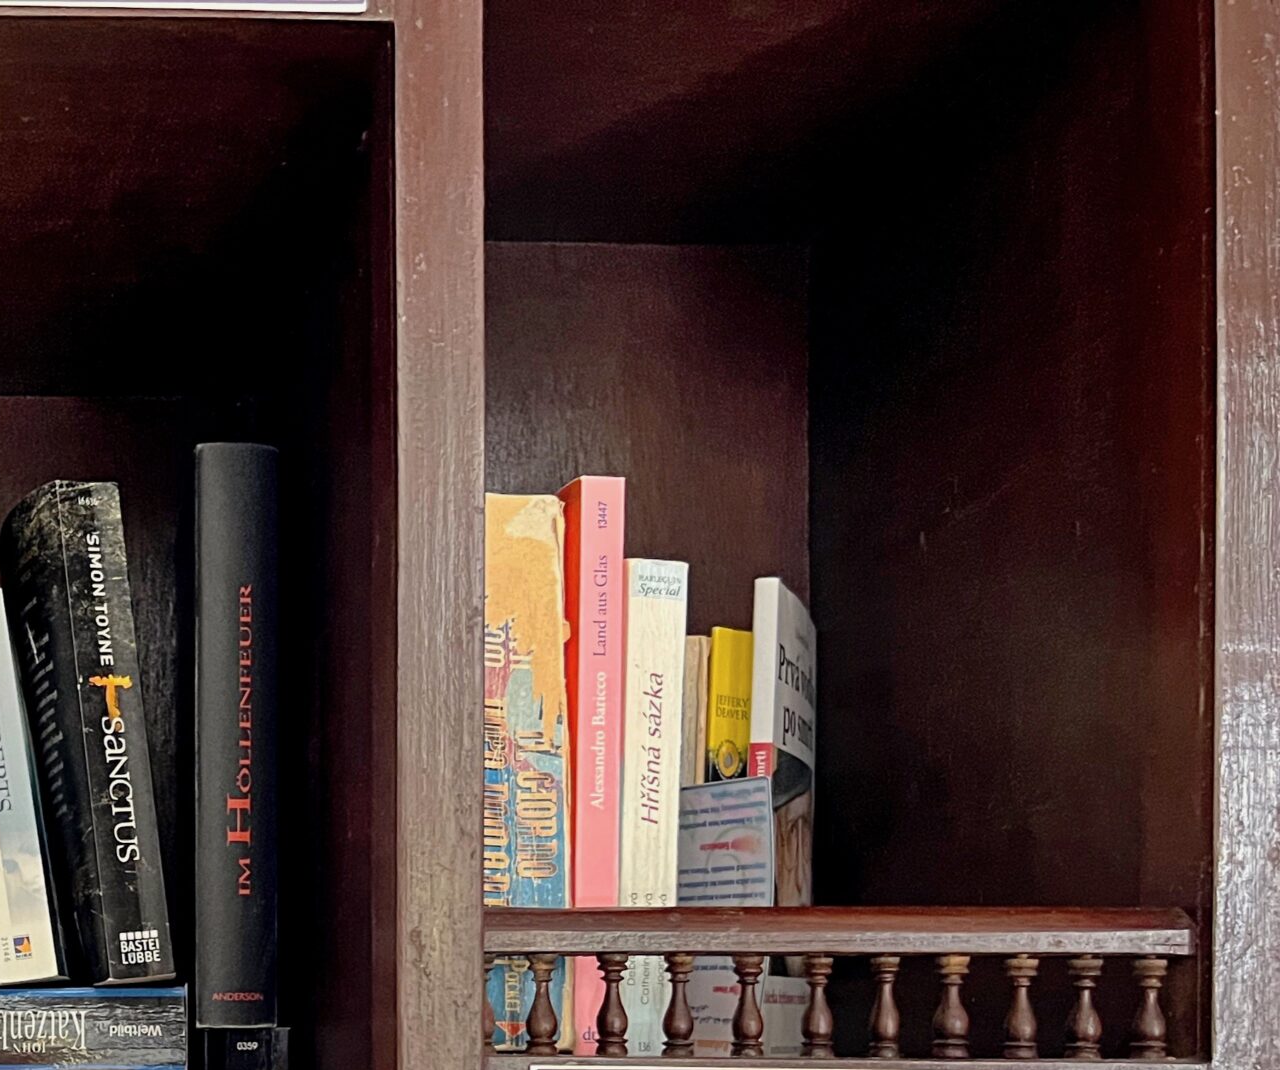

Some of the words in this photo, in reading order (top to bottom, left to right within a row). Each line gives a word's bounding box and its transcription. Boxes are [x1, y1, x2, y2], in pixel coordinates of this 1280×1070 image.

[598, 501, 607, 529] 13447
[86, 532, 105, 597] SIMON
[593, 555, 607, 587] Glas
[597, 592, 607, 614] aus
[638, 583, 681, 597] Special
[95, 603, 114, 667] TOYNE
[593, 620, 607, 657] Land
[592, 672, 607, 726] Baricco
[642, 672, 664, 739] sázka
[589, 730, 606, 810] Alessandro
[641, 745, 662, 825] Hříšná
[238, 858, 252, 895] IM
[120, 939, 160, 953] BASTEI
[212, 991, 264, 1001] ANDERSON
[108, 1022, 162, 1038] Weltbild
[237, 1041, 258, 1051] 0359
